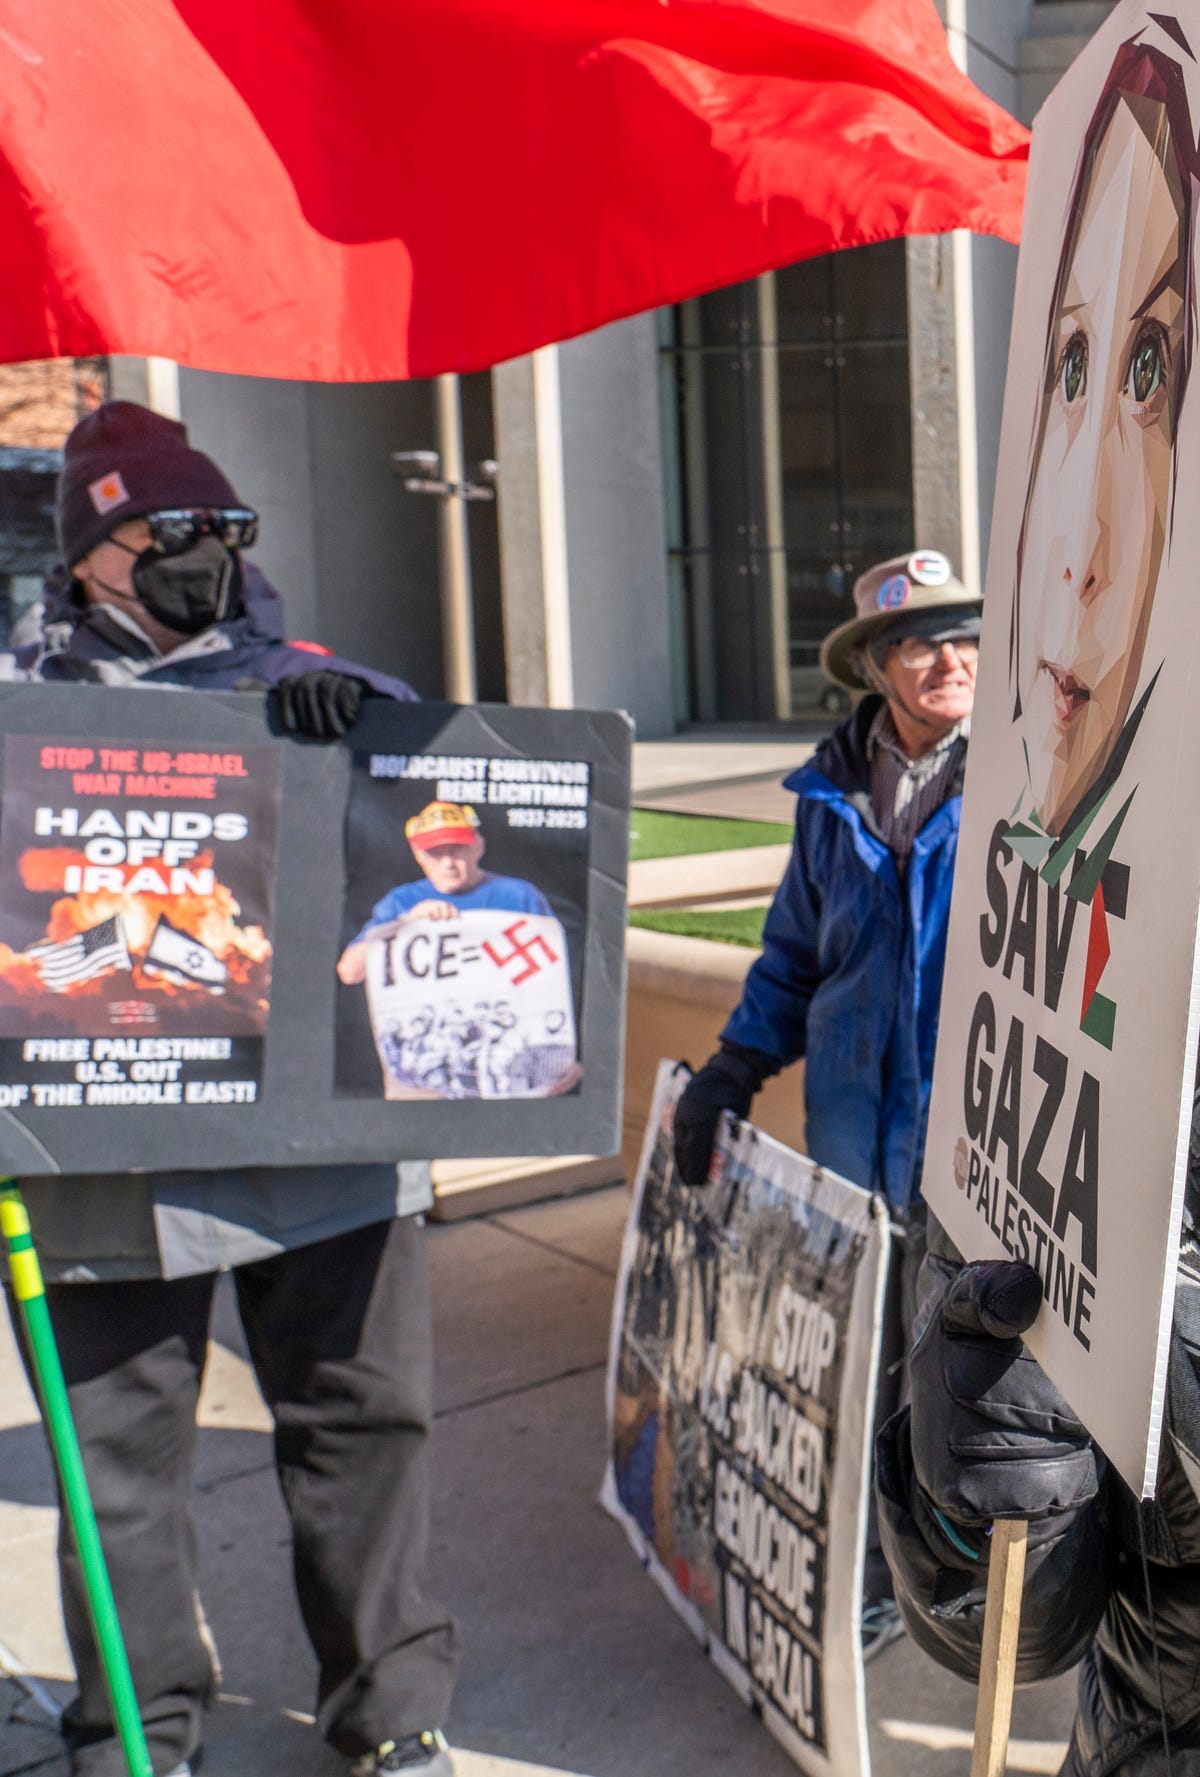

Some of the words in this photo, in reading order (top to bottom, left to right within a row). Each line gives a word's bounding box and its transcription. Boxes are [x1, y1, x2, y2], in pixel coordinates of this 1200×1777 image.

[41, 747, 94, 770] STOP
[100, 750, 138, 772] THE
[143, 752, 248, 777] US-ISRAEL
[370, 754, 488, 780] HOLOCAUST
[489, 759, 590, 785] SURVIVOR
[73, 773, 121, 795] WAR
[125, 776, 217, 799] MACHINE
[35, 807, 248, 841] HANDS
[84, 838, 199, 866] OFF
[64, 865, 215, 895] IRAN
[978, 818, 1131, 1052] SAVE
[23, 1039, 90, 1062] FREE
[92, 1038, 232, 1060] PALESTINE!
[75, 1061, 126, 1082] U.S.
[130, 1061, 182, 1082] OUT
[31, 1084, 83, 1106] THE
[86, 1082, 182, 1105] MIDDLE
[185, 1081, 257, 1104] EAST!
[963, 990, 1100, 1279] GAZA
[966, 1146, 1096, 1353] PALESTINE
[772, 1282, 836, 1397] STOP
[714, 1457, 817, 1629] GENOCIDE
[724, 1569, 748, 1665] IN
